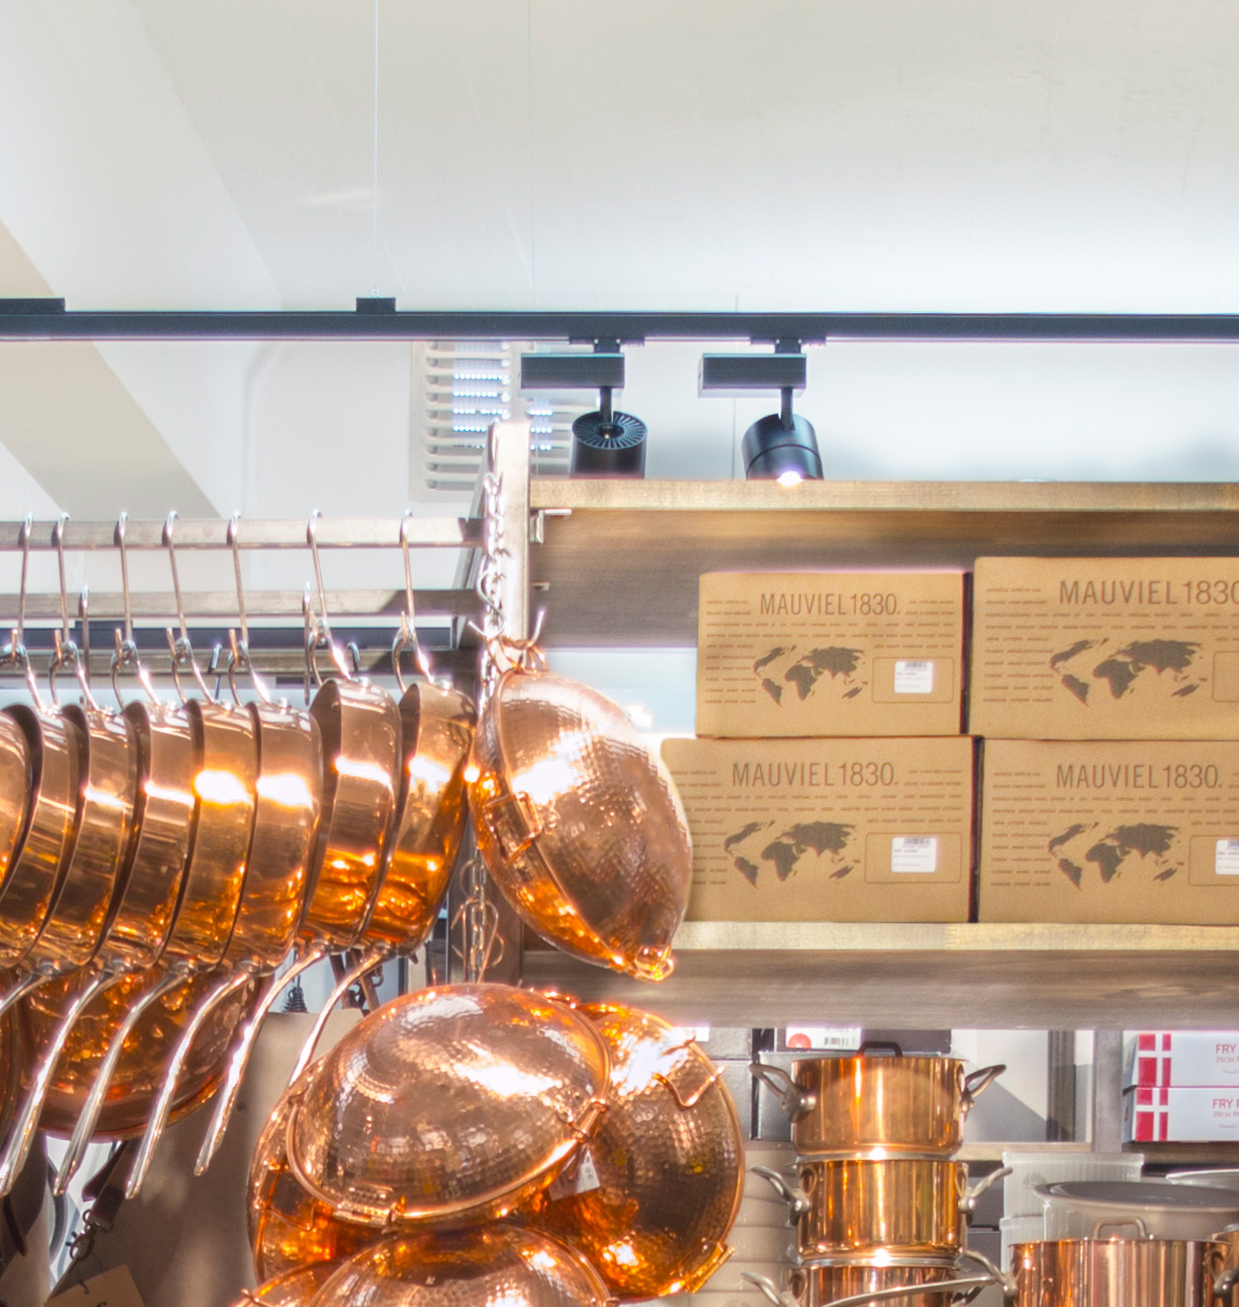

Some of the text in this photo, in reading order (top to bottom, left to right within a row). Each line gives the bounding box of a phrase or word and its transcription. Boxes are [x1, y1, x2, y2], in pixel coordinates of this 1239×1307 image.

[760, 593, 898, 616] MAUVIEL1830
[732, 762, 895, 787] MAUVIEL1830
[1056, 764, 1219, 789] MAUVIEL1830
[1215, 1044, 1237, 1054] FRY
[1212, 1099, 1233, 1109] FRY
